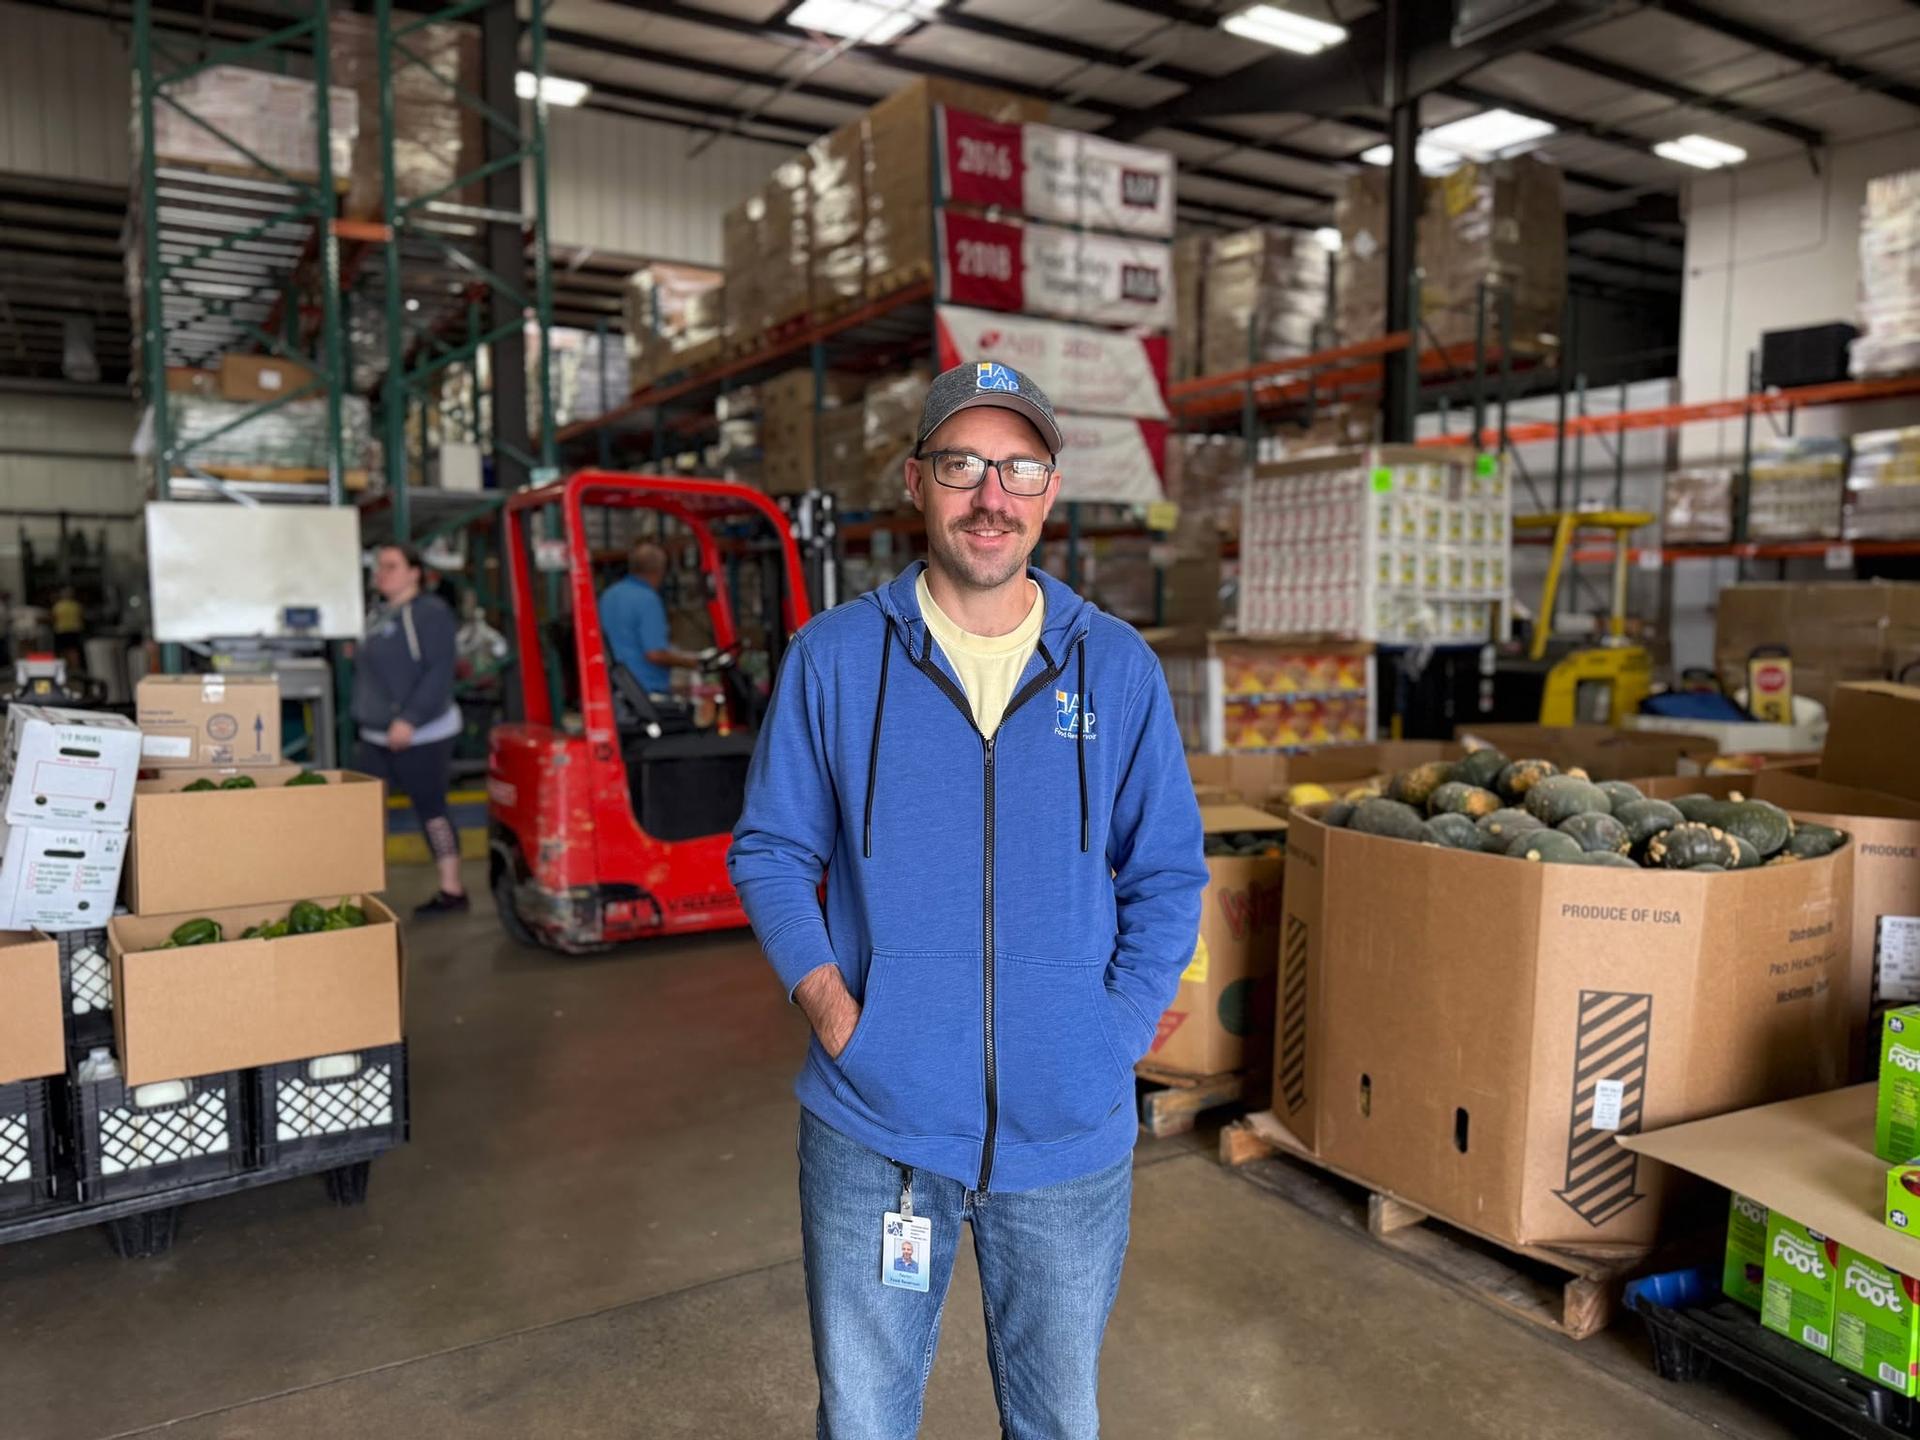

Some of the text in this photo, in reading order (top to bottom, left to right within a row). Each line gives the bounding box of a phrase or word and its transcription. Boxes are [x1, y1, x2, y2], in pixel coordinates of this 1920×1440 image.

[1562, 904, 1681, 924] PRODUCE OF USA
